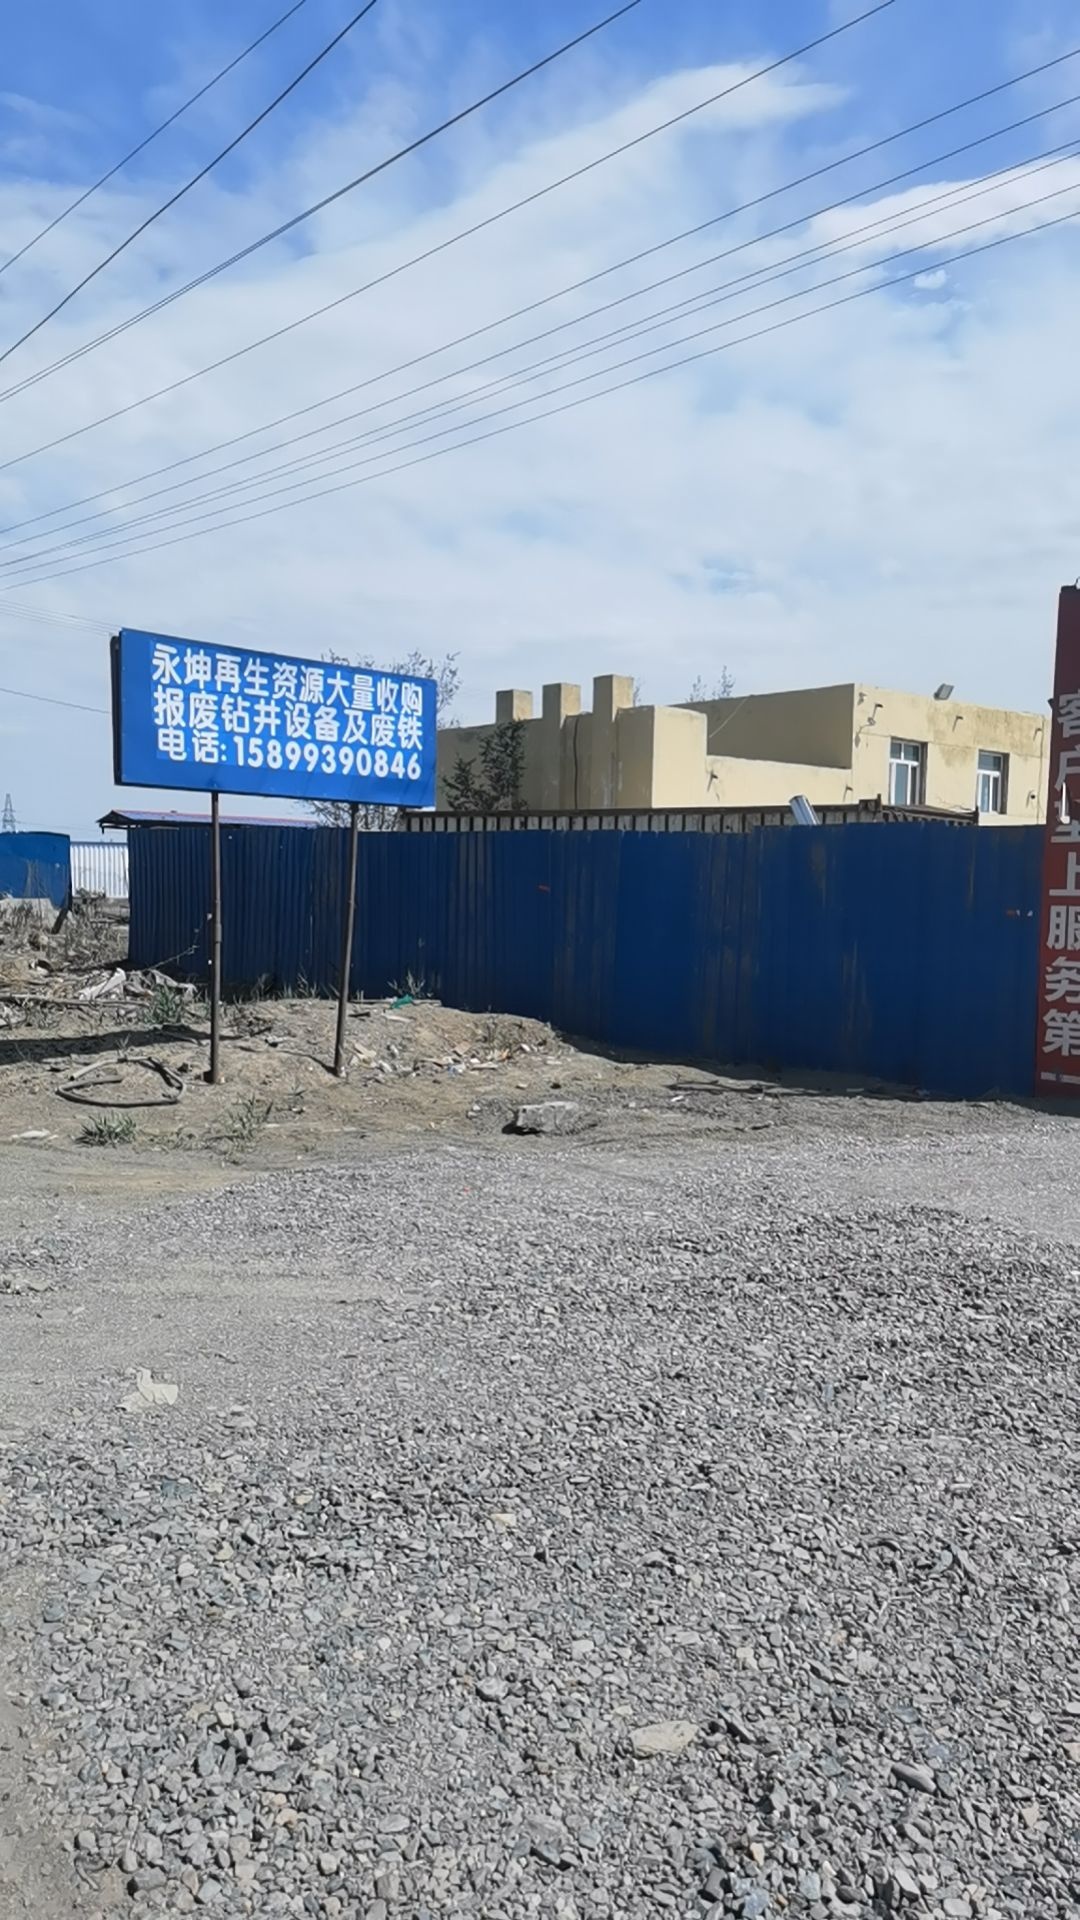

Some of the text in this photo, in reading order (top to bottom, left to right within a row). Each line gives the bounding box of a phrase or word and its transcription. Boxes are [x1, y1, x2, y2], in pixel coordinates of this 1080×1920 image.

[152, 643, 422, 715] 永坤再生资源大量收购
[153, 684, 422, 750] 报废钻井设备及废铁
